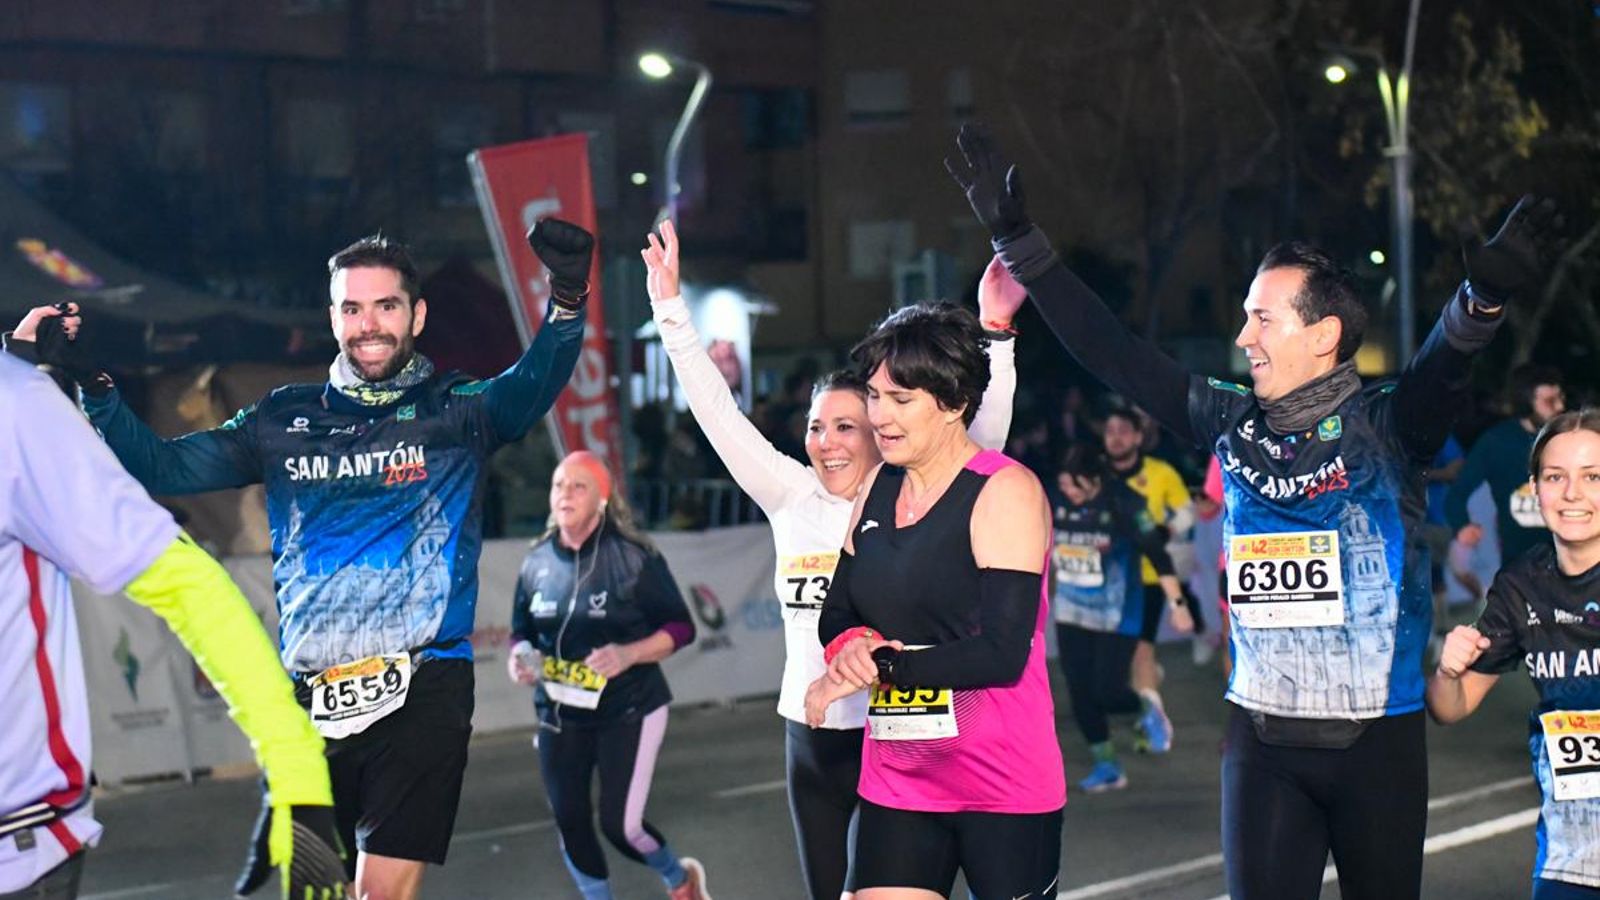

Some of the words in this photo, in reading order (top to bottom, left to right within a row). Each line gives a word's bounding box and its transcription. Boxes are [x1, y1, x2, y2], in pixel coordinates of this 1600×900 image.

[285, 455, 329, 481] SAN
[336, 441, 425, 479] ANTÓN
[384, 461, 428, 485] 2025
[1252, 539, 1268, 554] 42
[801, 556, 821, 570] 42
[1238, 559, 1329, 592] 6306
[1525, 651, 1565, 679] SAN
[323, 667, 402, 711] 6559
[1568, 716, 1587, 729] 42
